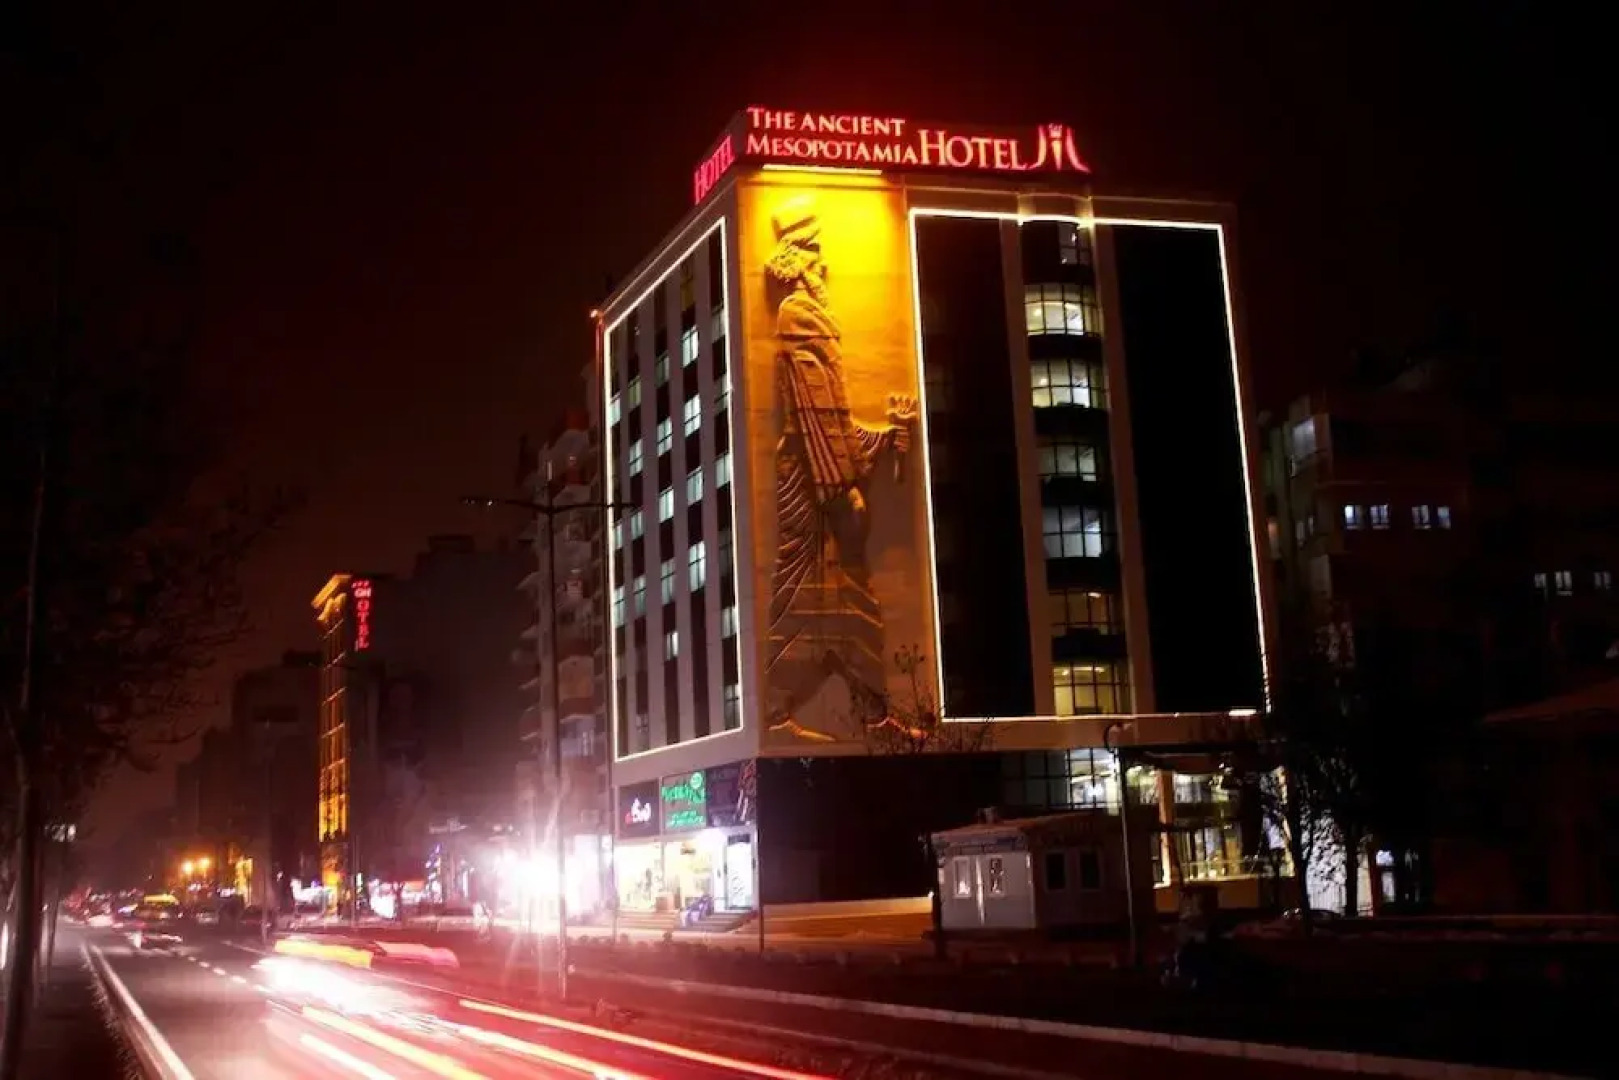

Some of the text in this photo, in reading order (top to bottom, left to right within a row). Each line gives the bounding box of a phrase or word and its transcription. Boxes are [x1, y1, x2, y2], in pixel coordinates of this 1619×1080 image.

[747, 107, 905, 136] THE ANCIENT
[694, 135, 735, 205] HOTEL
[746, 129, 1028, 170] MESOPOTAMIA HOTEL
